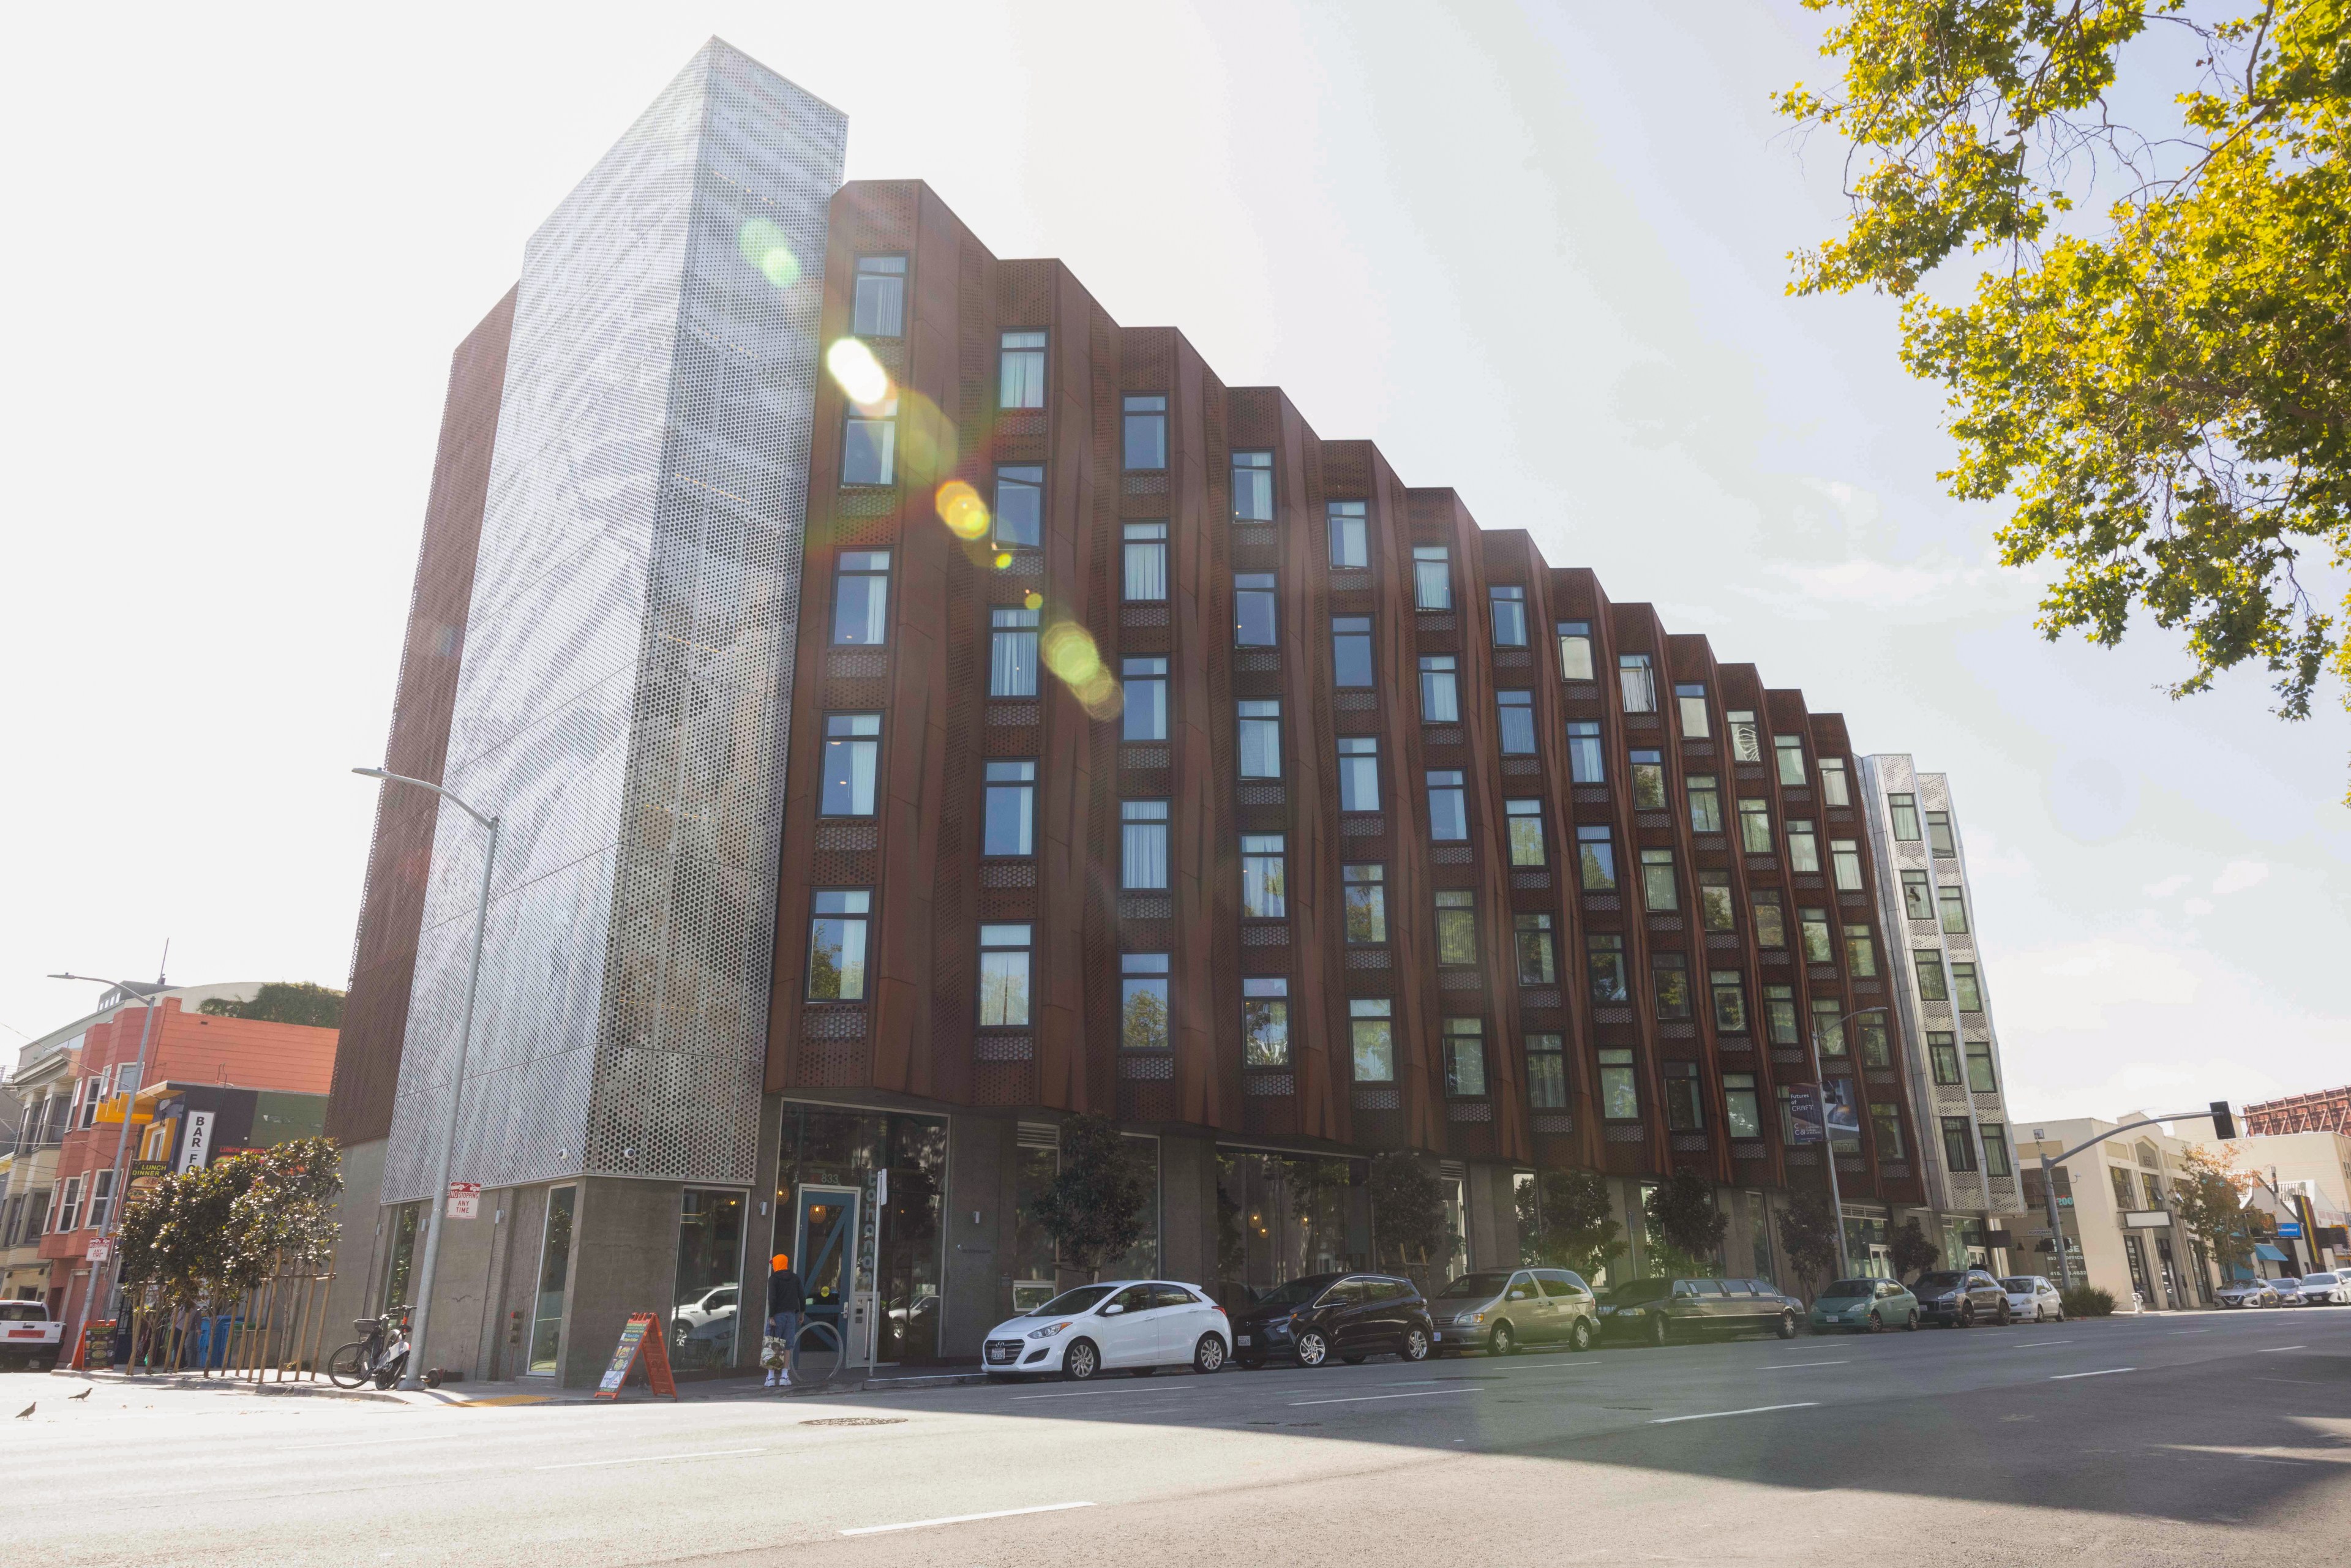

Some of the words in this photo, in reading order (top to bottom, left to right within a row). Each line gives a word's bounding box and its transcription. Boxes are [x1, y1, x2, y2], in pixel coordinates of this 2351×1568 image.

[192, 1116, 204, 1148] BAR
[2143, 1156, 2152, 1166] 855
[821, 1173, 839, 1184] 833
